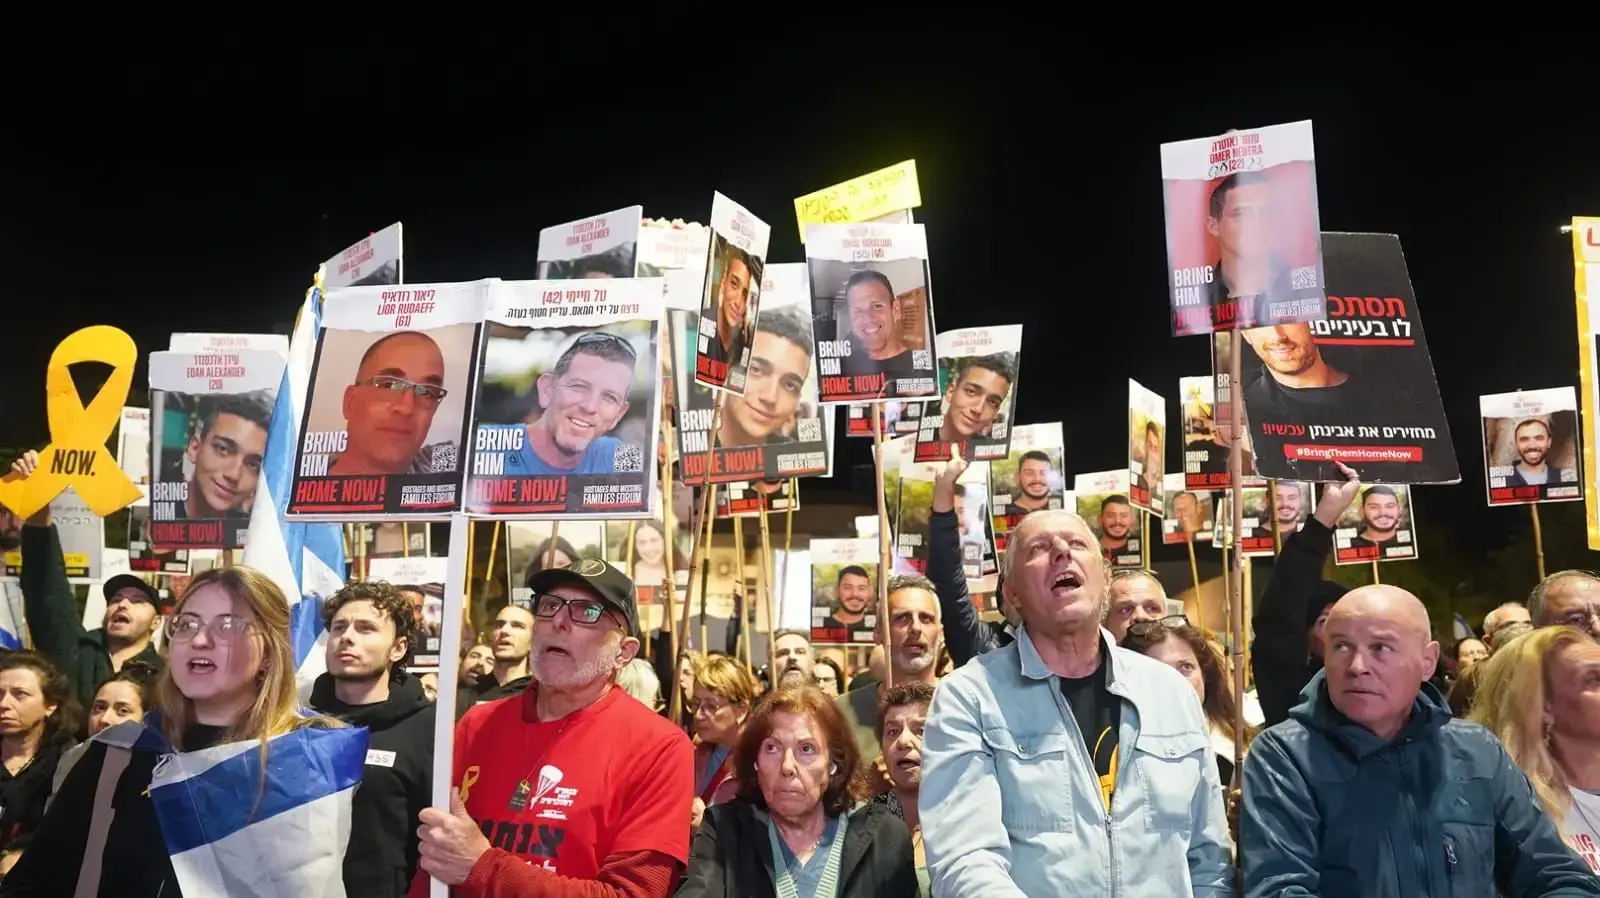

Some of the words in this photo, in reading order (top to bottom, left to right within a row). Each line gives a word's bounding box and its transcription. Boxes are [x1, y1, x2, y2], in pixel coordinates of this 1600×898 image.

[1209, 149, 1231, 165] OMER
[1232, 145, 1264, 158] NEUTRA
[1228, 159, 1245, 172] (22)
[1173, 265, 1214, 288] BRING
[381, 289, 411, 304] רודאיף
[413, 289, 435, 301] ליאור
[542, 292, 564, 306] (42)
[594, 289, 607, 302] טל
[1175, 286, 1200, 307] HIM
[377, 304, 396, 316] LIOR
[397, 302, 436, 315] RUDAEFF
[599, 305, 609, 315] ידי
[609, 304, 619, 315] על
[1327, 295, 1407, 318] תסתכ
[394, 314, 411, 328] (61)
[1392, 318, 1411, 337] לו
[819, 340, 851, 359] BRING
[187, 367, 205, 378] EDAN
[206, 367, 246, 378] ALEXANDER
[820, 358, 841, 375] HIM
[208, 379, 223, 391] (20)
[822, 376, 853, 394] HOME
[854, 372, 887, 393] NOW!
[1263, 423, 1305, 436] עכשיו!
[1308, 424, 1355, 441] אבינתן
[1358, 426, 1380, 438] את
[1383, 427, 1436, 440] מחזירים
[303, 430, 349, 454] BRING
[476, 428, 524, 451] BRING
[682, 431, 709, 453] HIM
[724, 447, 765, 473] NOW!
[1185, 451, 1209, 462] BRING
[1295, 447, 1412, 460] #BringThemHomeNow
[50, 449, 96, 477] NOW.
[300, 453, 330, 477] HIM
[473, 452, 504, 476] HIM
[1186, 472, 1207, 485] HOME
[153, 482, 189, 501] BRING
[295, 480, 340, 504] HOME
[341, 475, 388, 503] NOW!
[401, 492, 432, 506] FAMILIES
[432, 489, 456, 504] FORUM
[473, 479, 518, 505] HOME
[520, 476, 567, 504] NOW!
[583, 492, 616, 505] FAMILIES
[616, 491, 642, 504] FORUM
[153, 502, 176, 521] HIM
[154, 523, 186, 543] HOME
[188, 520, 223, 544] NOW!
[899, 533, 922, 547] BRING
